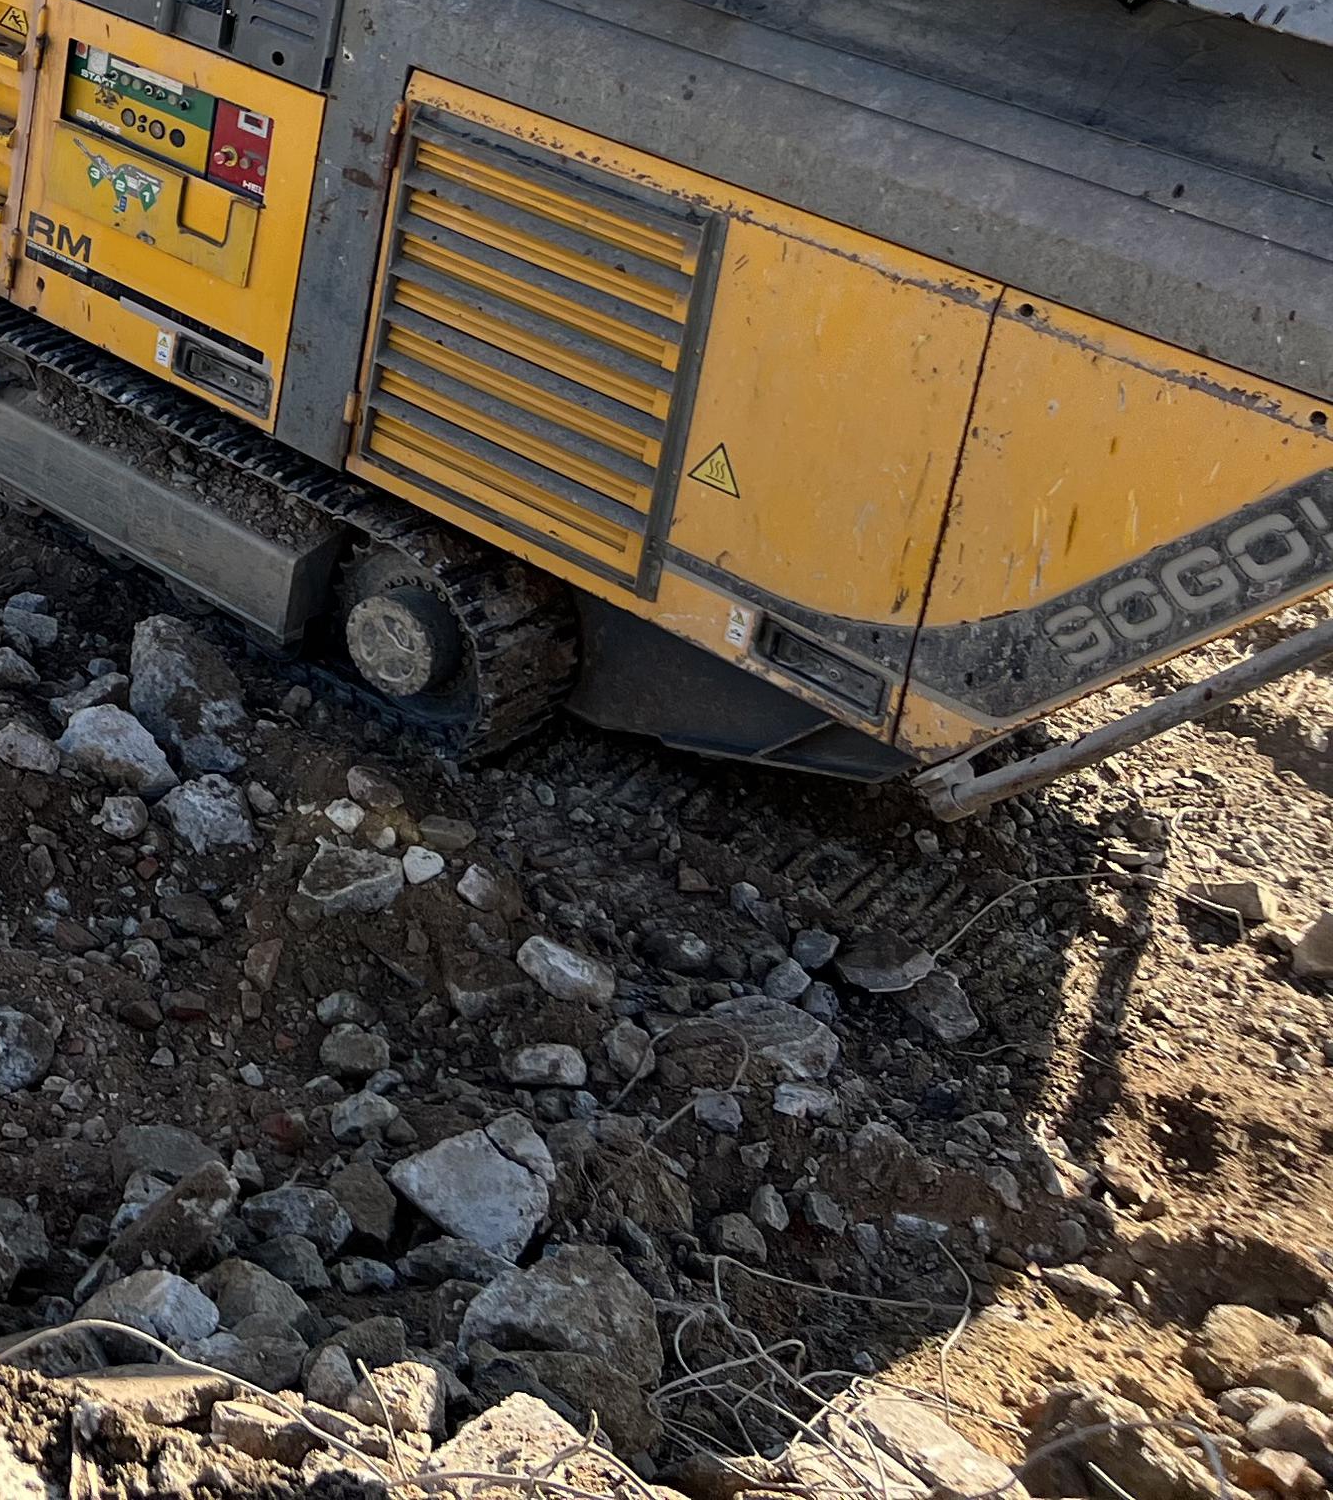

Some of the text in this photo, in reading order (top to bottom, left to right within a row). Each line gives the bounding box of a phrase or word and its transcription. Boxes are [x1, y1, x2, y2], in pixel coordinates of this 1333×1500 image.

[89, 167, 100, 180] 3
[115, 179, 126, 193] 2
[242, 179, 265, 196] HEL
[142, 191, 150, 203] 1
[28, 210, 92, 264] RM
